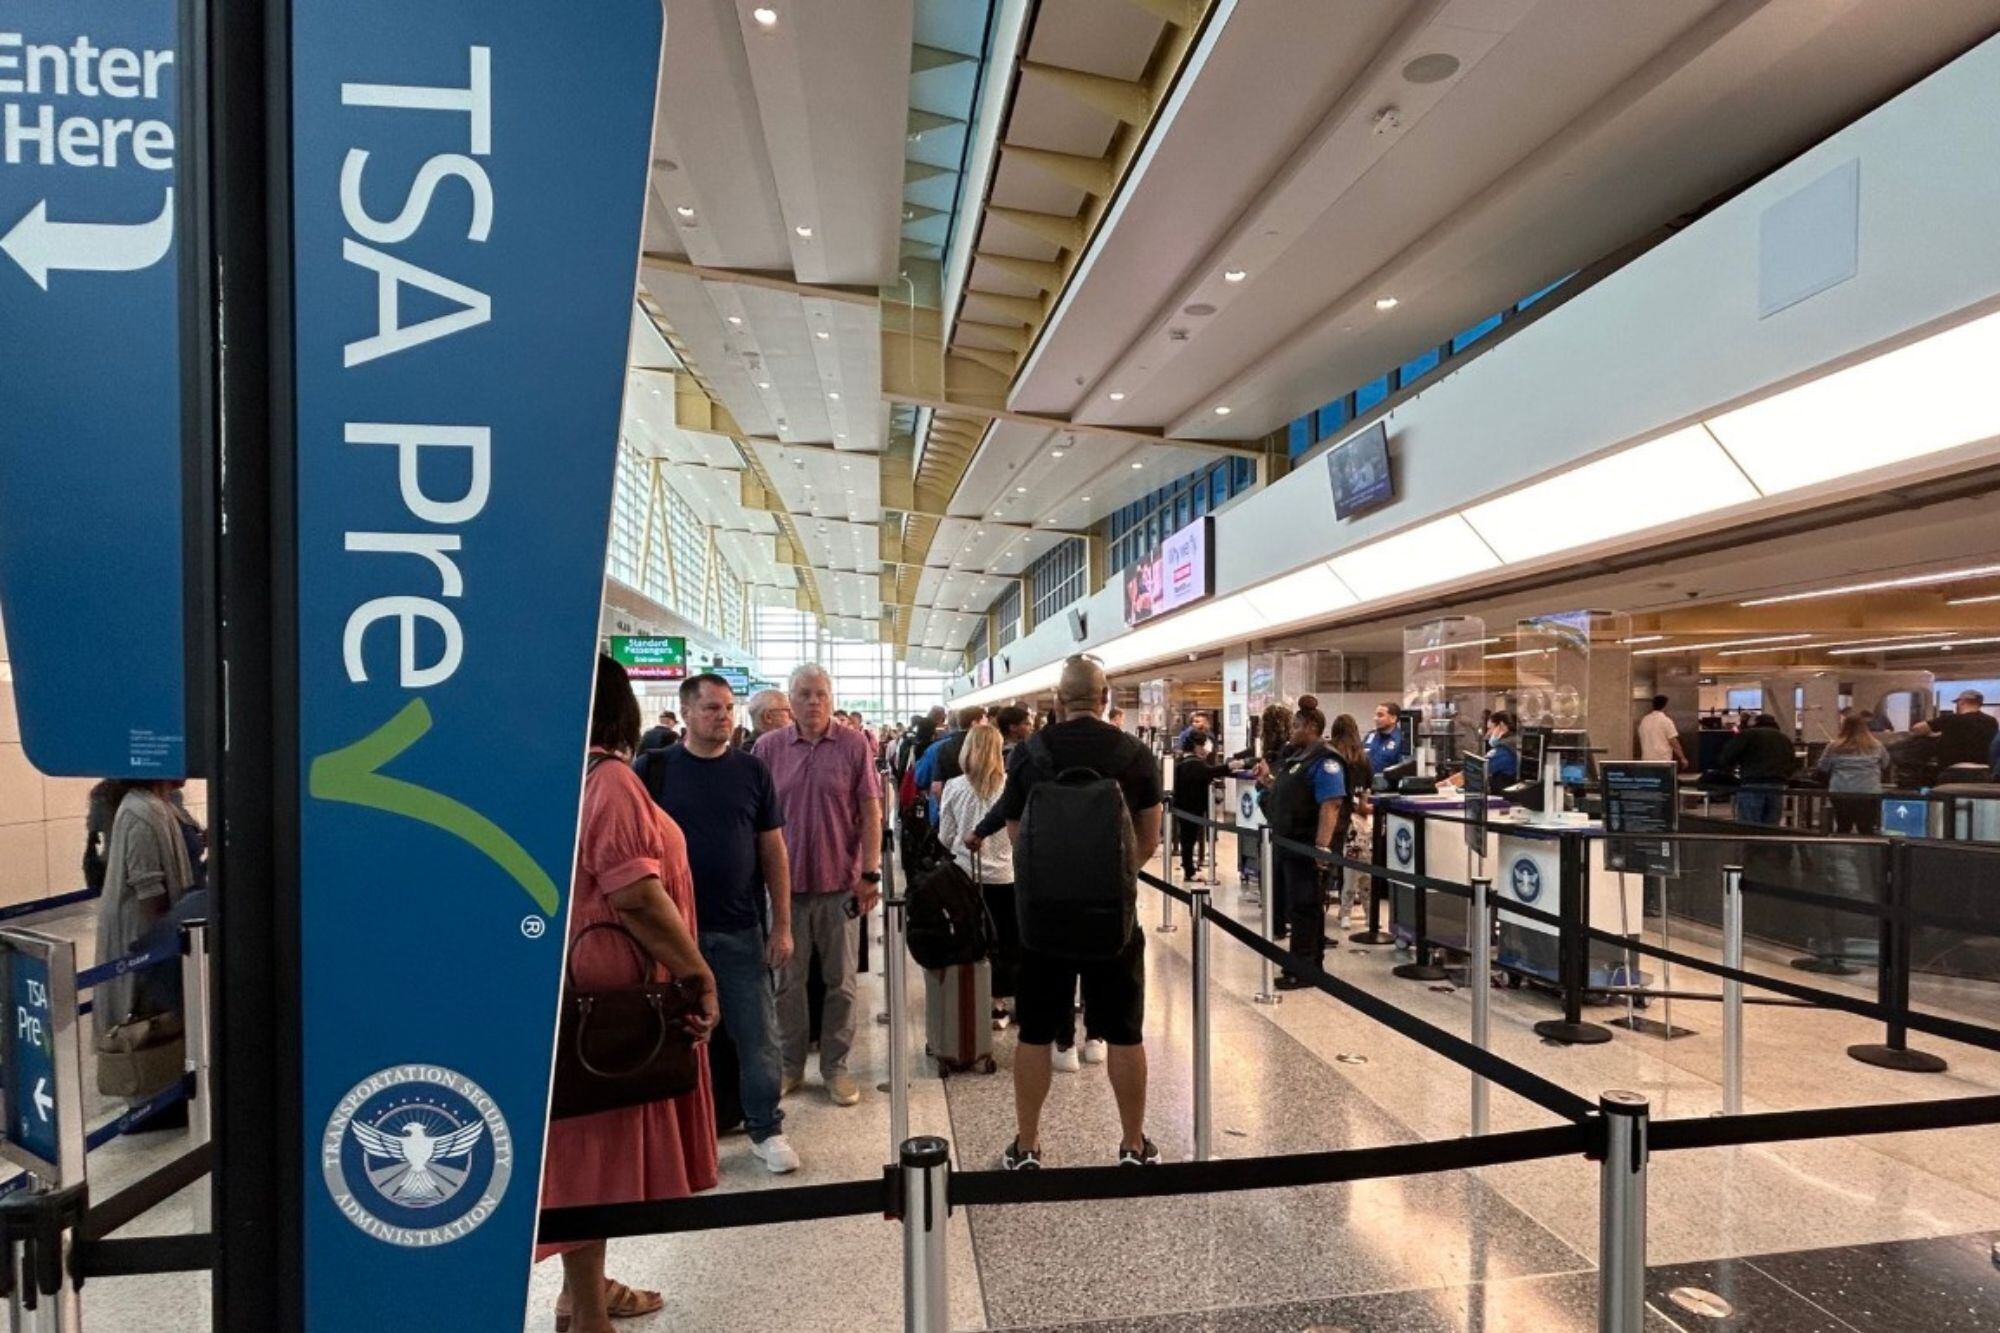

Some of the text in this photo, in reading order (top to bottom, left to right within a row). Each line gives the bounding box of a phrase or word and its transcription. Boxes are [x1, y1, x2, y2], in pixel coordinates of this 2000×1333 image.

[0, 32, 175, 98] Enter
[4, 103, 175, 170] Here
[339, 46, 494, 368] TSA
[343, 422, 491, 688] Pre
[623, 646, 673, 656] Passengers
[628, 639, 669, 648] Standard
[26, 979, 48, 1009] TSA
[18, 1005, 42, 1046] Pre
[325, 1066, 511, 1168] TRANSPORTATION SECURITY
[335, 1194, 497, 1245] ADMINISTRATION
